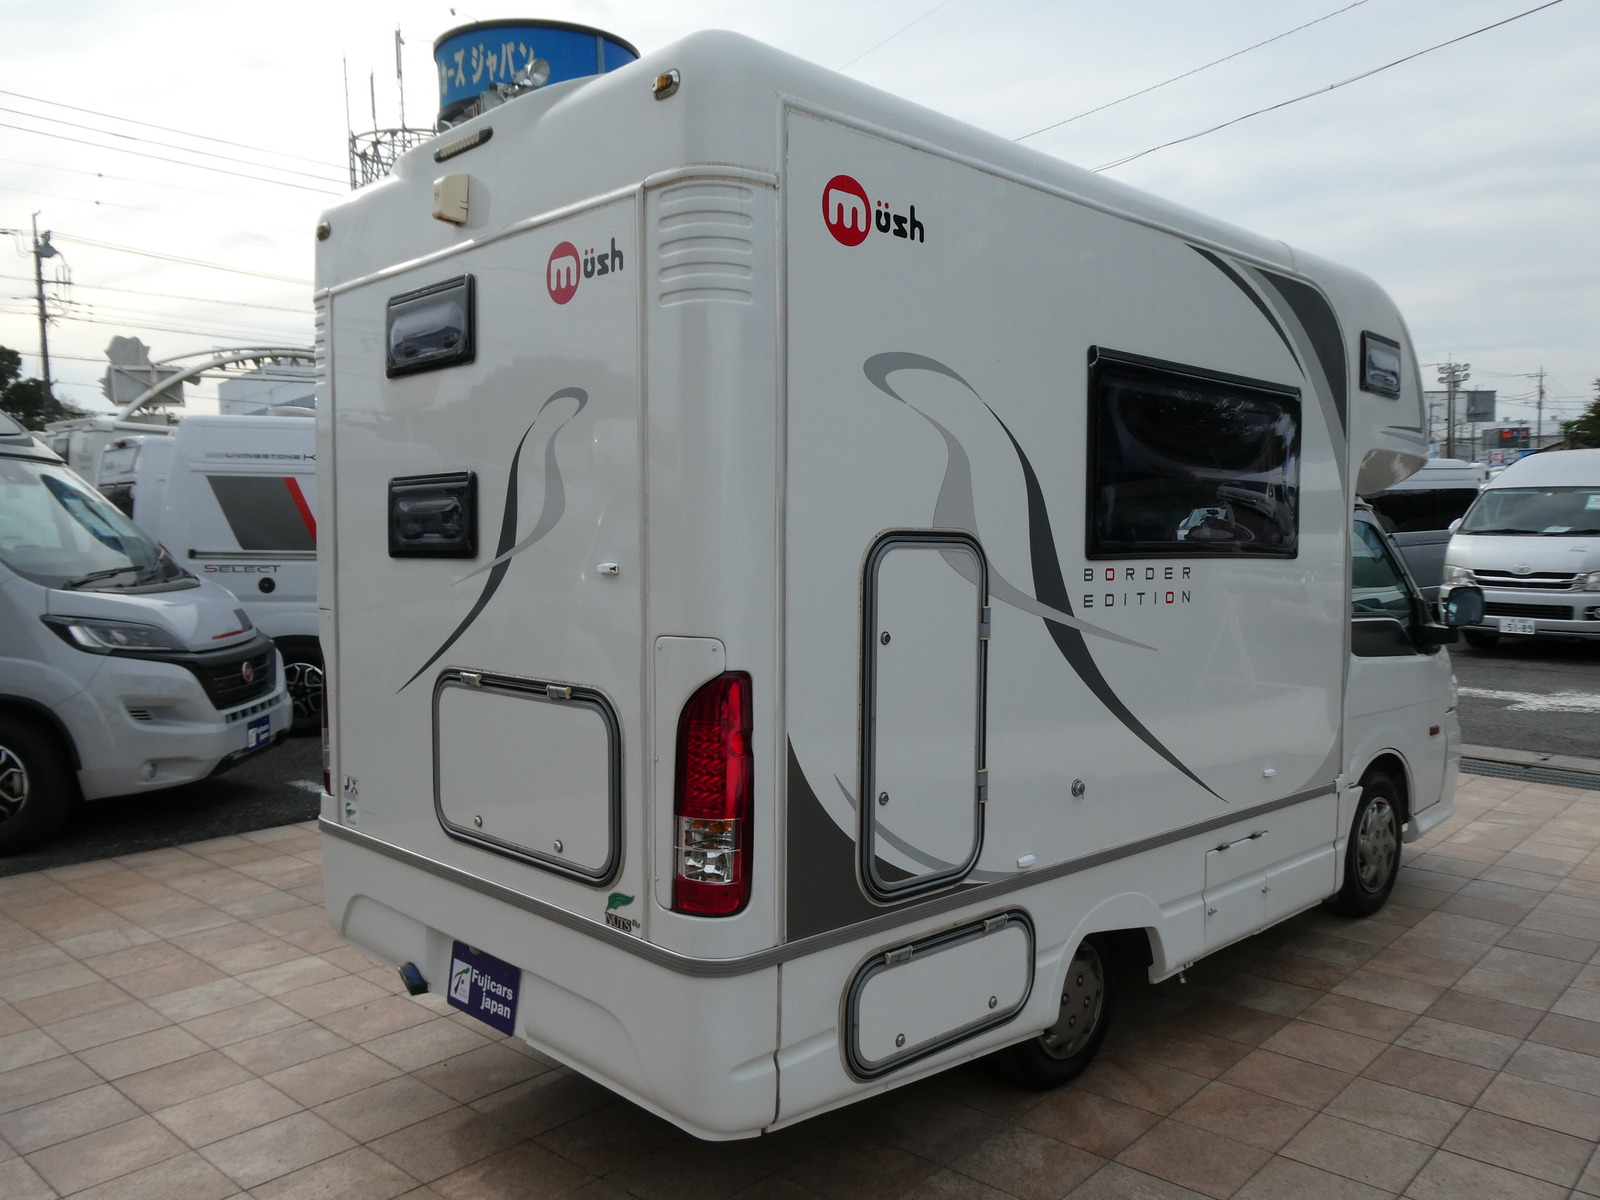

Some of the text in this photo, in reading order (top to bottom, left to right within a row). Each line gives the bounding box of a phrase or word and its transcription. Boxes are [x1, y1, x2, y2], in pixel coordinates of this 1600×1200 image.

[203, 564, 282, 573] SELECT
[1083, 566, 1191, 582] BORDER
[1083, 590, 1191, 608] EDITION
[605, 911, 632, 932] NUTS
[471, 968, 514, 1001] Fujicars
[480, 992, 512, 1019] japan
